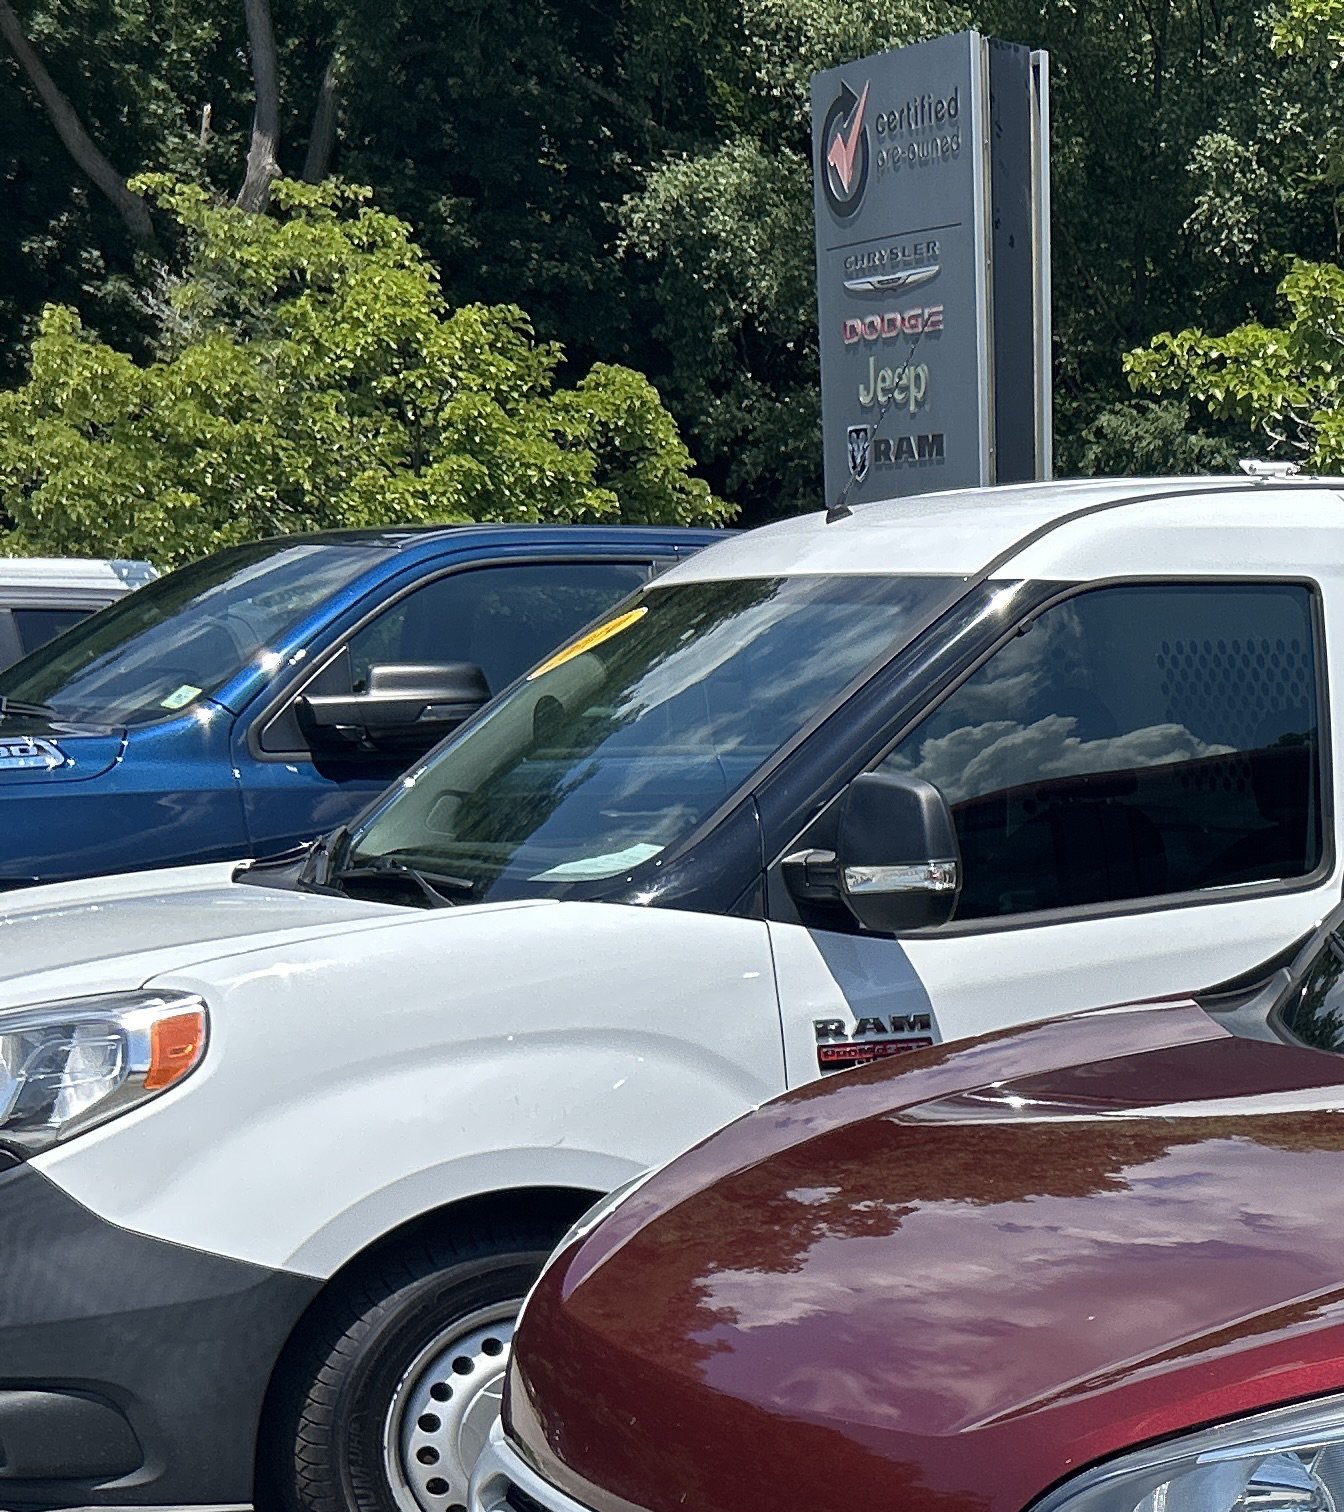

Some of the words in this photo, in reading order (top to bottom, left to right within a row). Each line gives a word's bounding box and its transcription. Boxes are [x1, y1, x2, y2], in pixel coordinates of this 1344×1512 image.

[876, 85, 959, 135] certified
[877, 125, 961, 173] pre-owned
[844, 240, 939, 271] CHRYSLER
[843, 304, 944, 344] DODGE
[859, 355, 928, 413] Jeep
[874, 433, 946, 465] RAM
[813, 1013, 931, 1042] RAM
